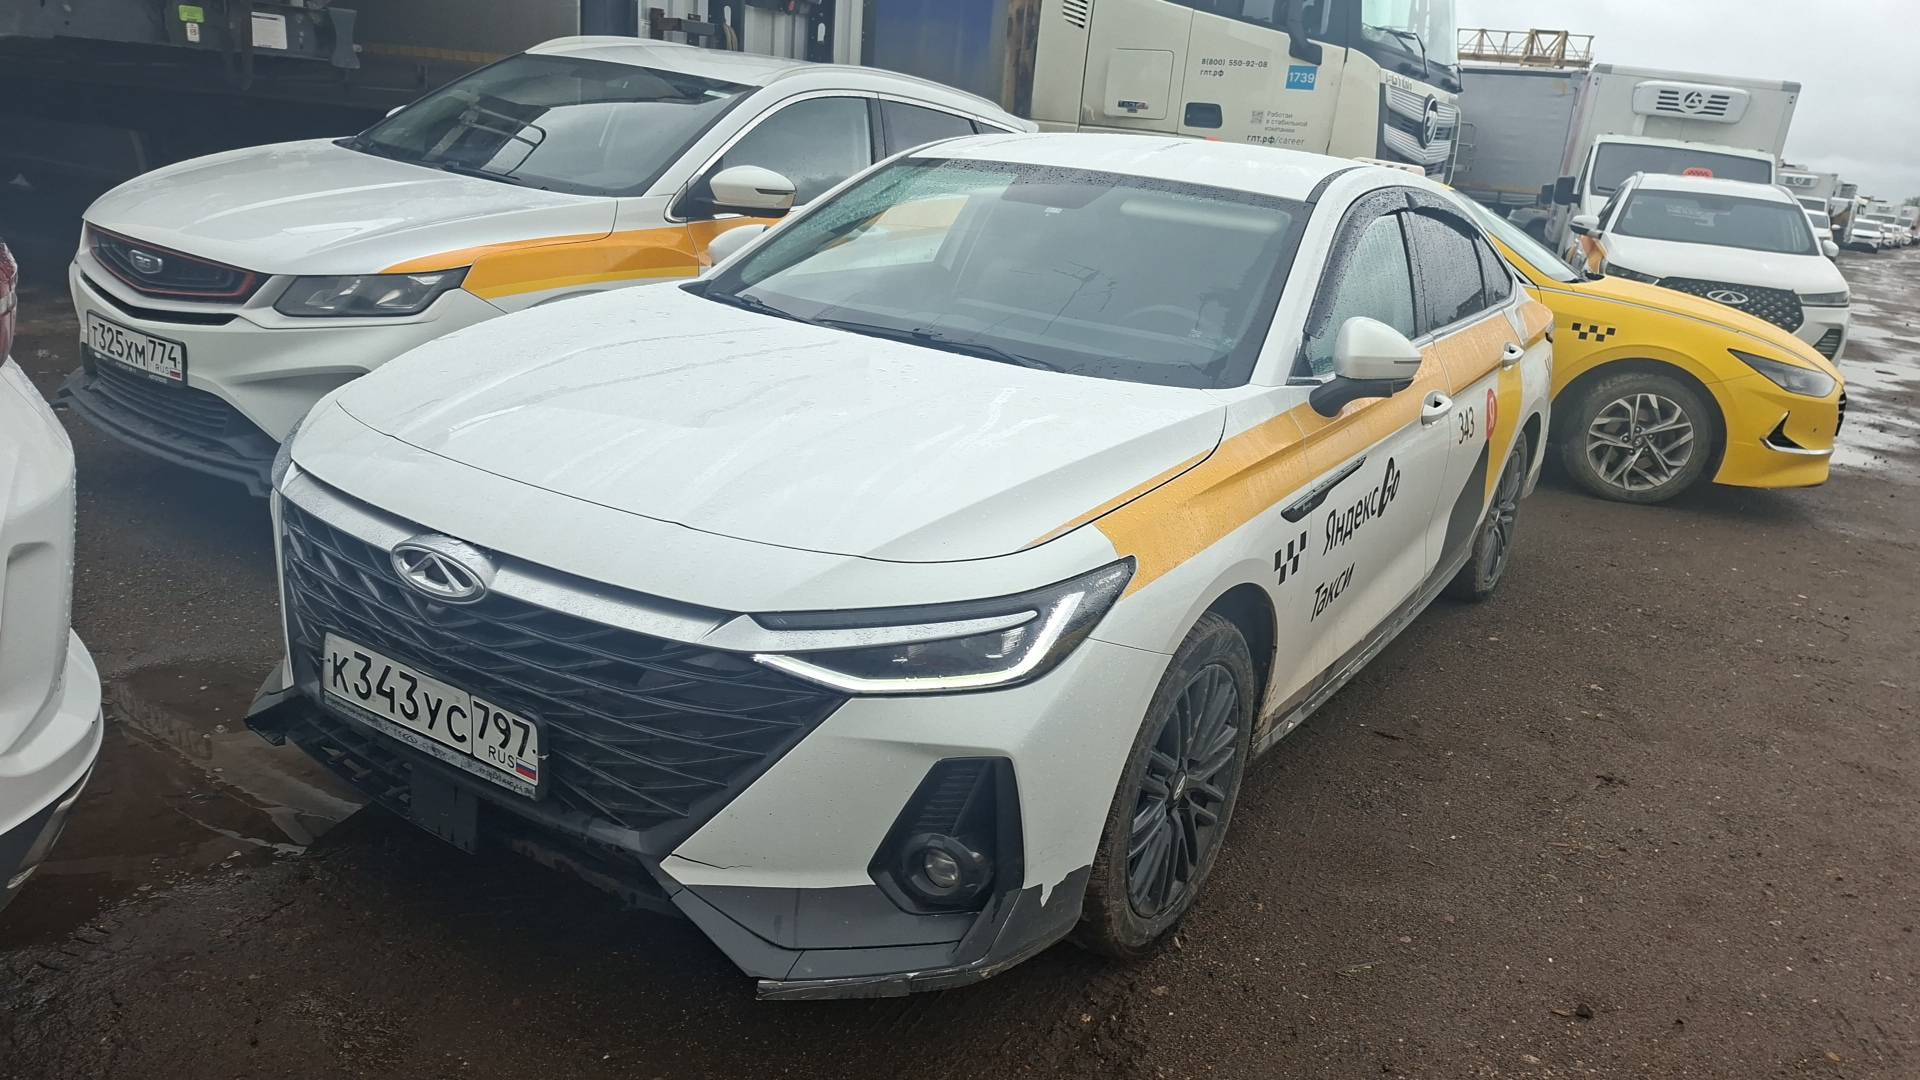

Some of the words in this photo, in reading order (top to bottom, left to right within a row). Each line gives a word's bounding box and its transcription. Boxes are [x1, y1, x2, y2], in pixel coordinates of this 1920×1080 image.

[1201, 58, 1226, 67] 8(800)
[1228, 59, 1268, 68] 550-92-08
[1288, 71, 1315, 84] 1739
[1458, 406, 1475, 445] 343
[1310, 562, 1356, 622] Такси
[488, 744, 516, 769] RUS
